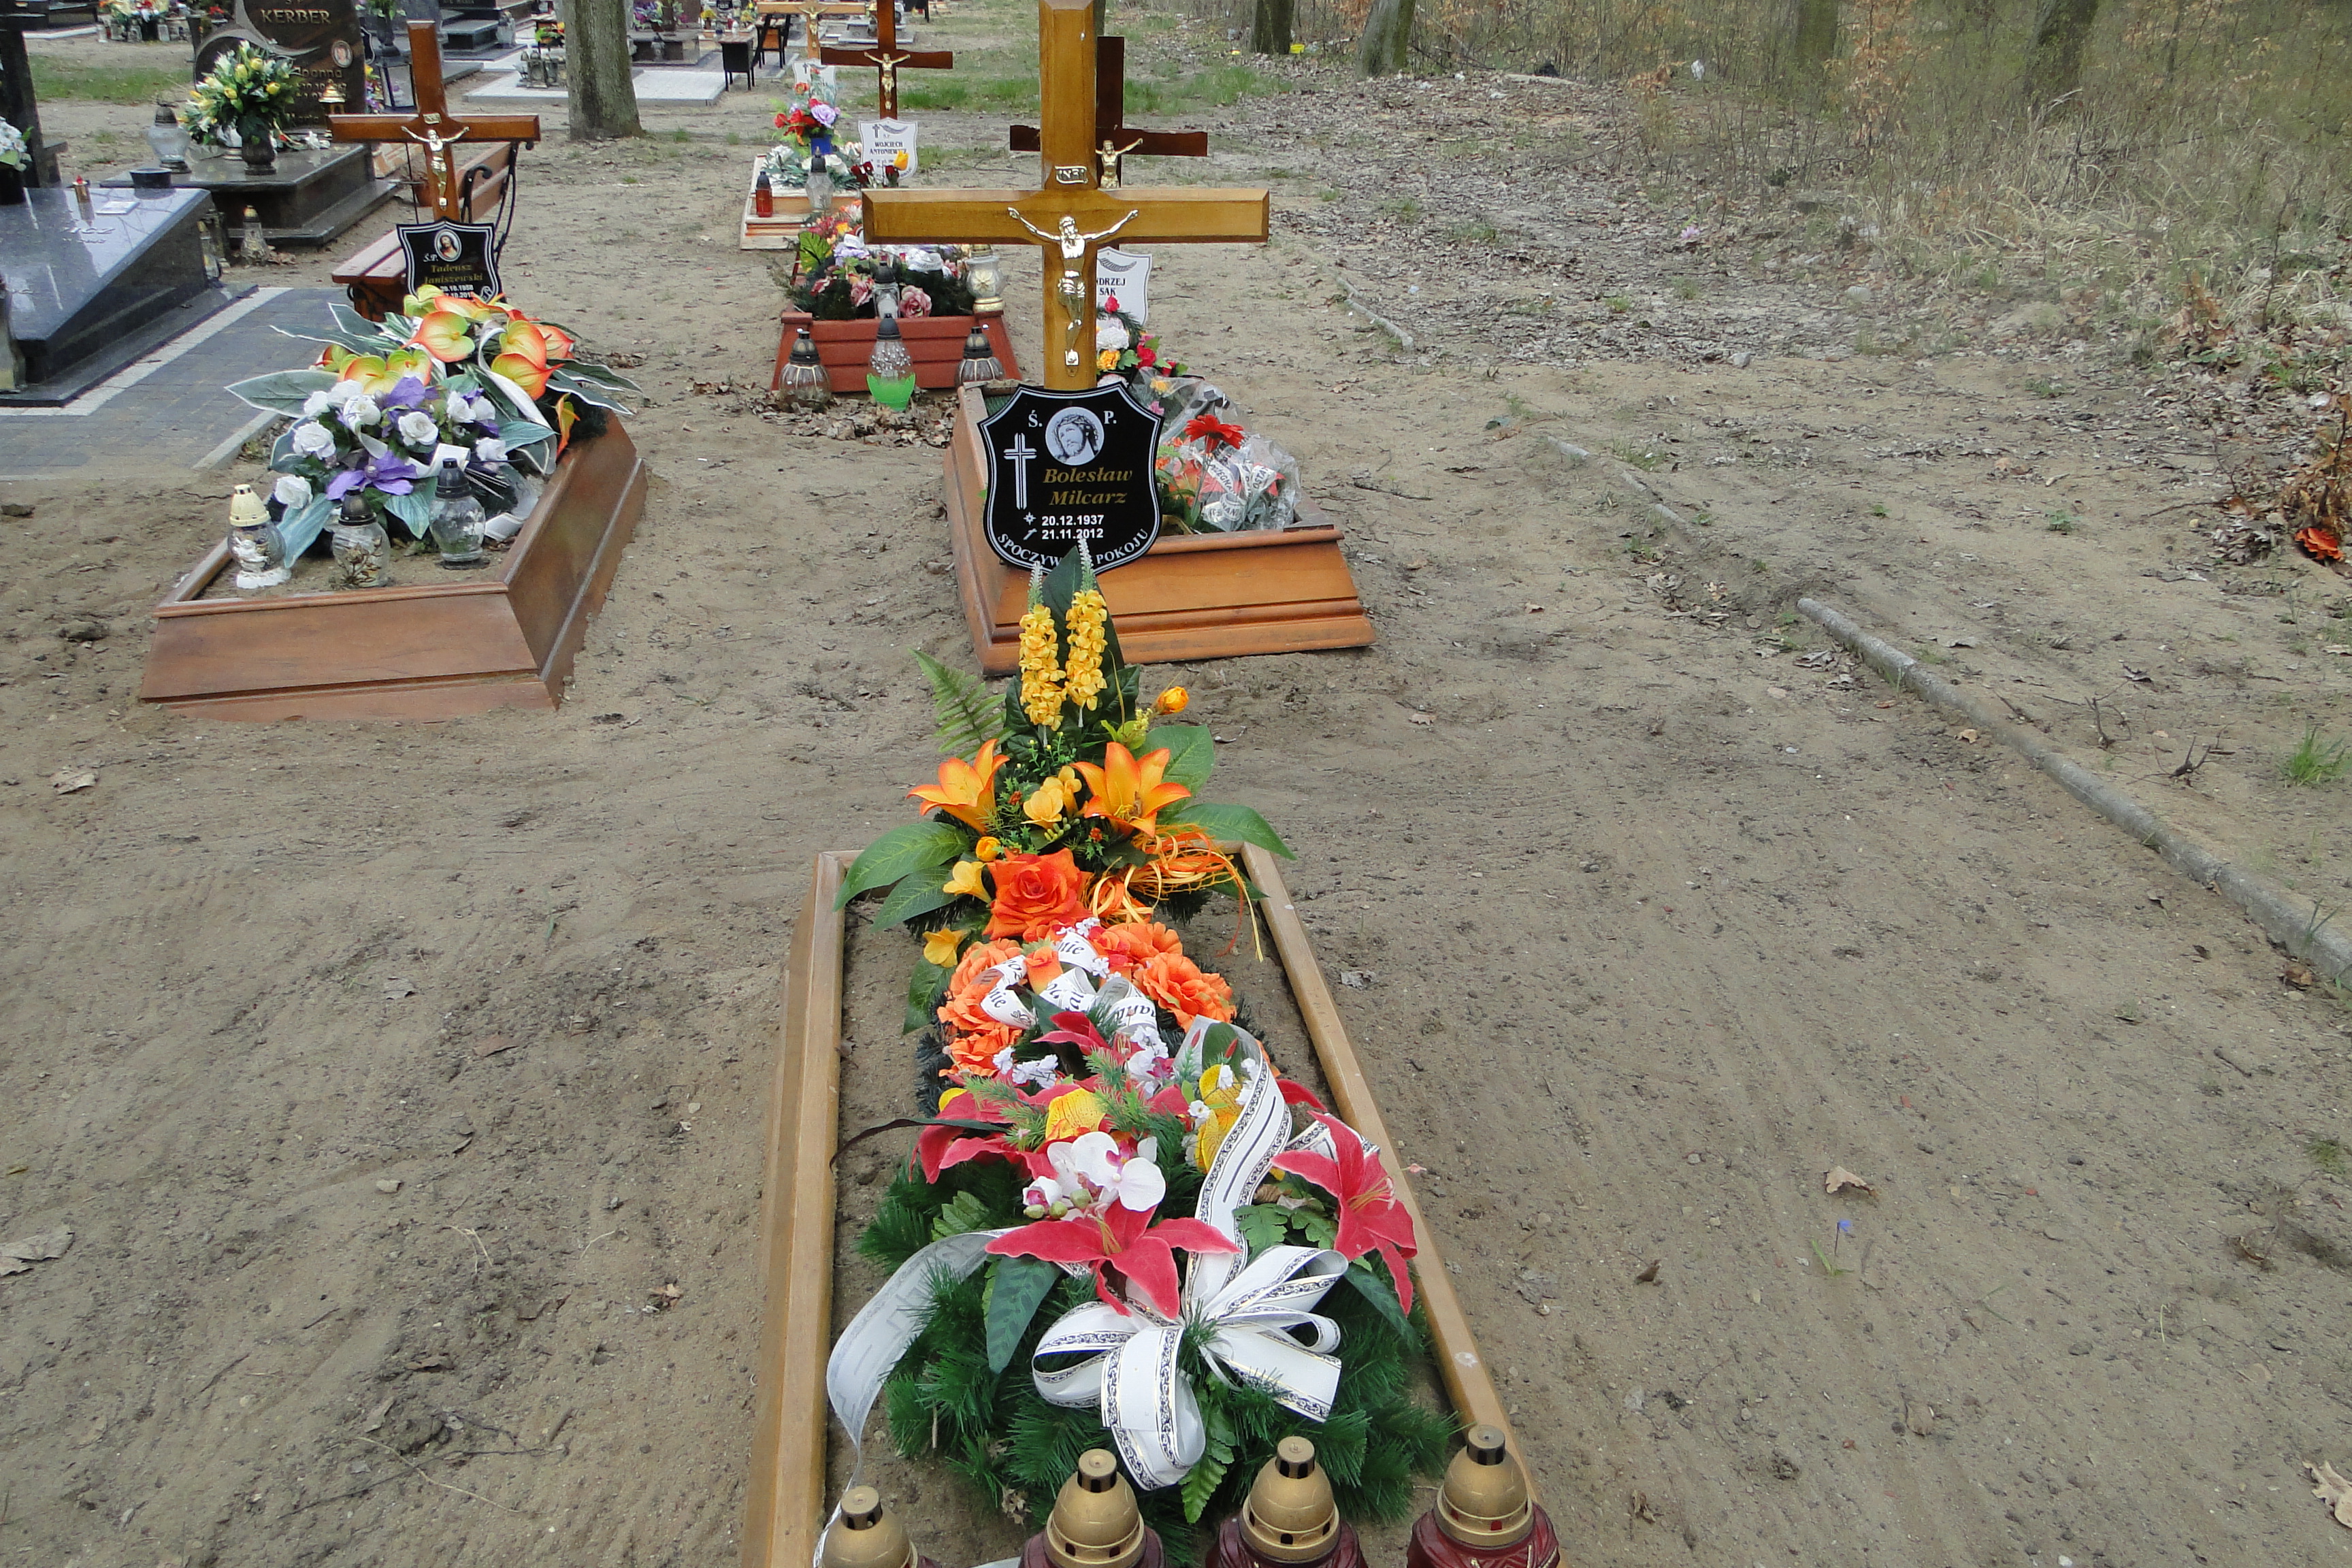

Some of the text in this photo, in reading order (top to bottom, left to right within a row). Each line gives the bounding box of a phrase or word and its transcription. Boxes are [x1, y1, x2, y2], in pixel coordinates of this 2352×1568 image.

[261, 9, 331, 24] KERBER
[431, 264, 472, 273] Tadeusz
[423, 273, 483, 284] Janiszewski
[1097, 278, 1126, 286] DRZEJ
[1028, 410, 1117, 427] Ś. P.
[1043, 467, 1133, 484] Bolesław
[1049, 491, 1127, 506] Milcarz
[1041, 514, 1105, 526] 20.12.1937
[1041, 528, 1104, 540] 21.11.2012
[997, 528, 1149, 568] SPOCZYW POKOJU
